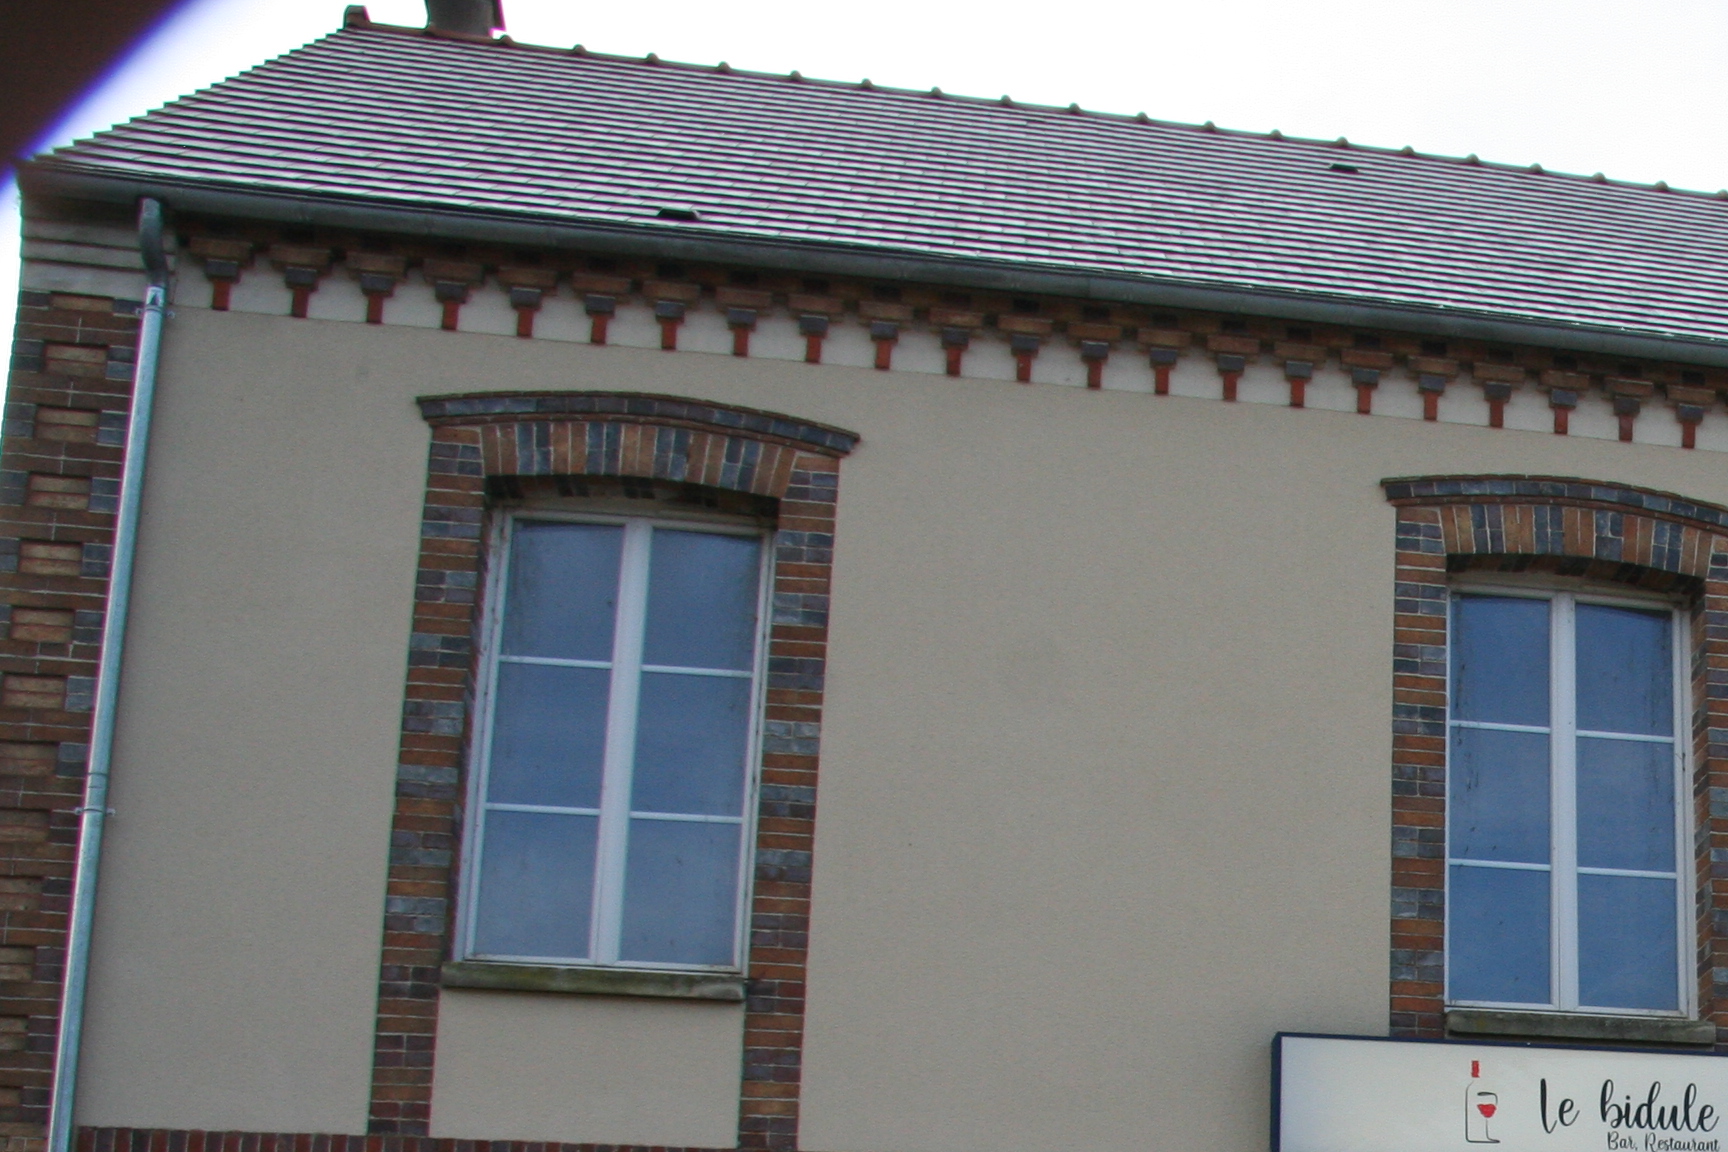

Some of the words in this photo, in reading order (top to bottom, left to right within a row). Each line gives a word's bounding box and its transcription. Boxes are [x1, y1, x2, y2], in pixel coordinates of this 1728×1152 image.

[1539, 1078, 1581, 1134] le
[1600, 1079, 1720, 1132] bidule
[1607, 1131, 1639, 1151] Bar,
